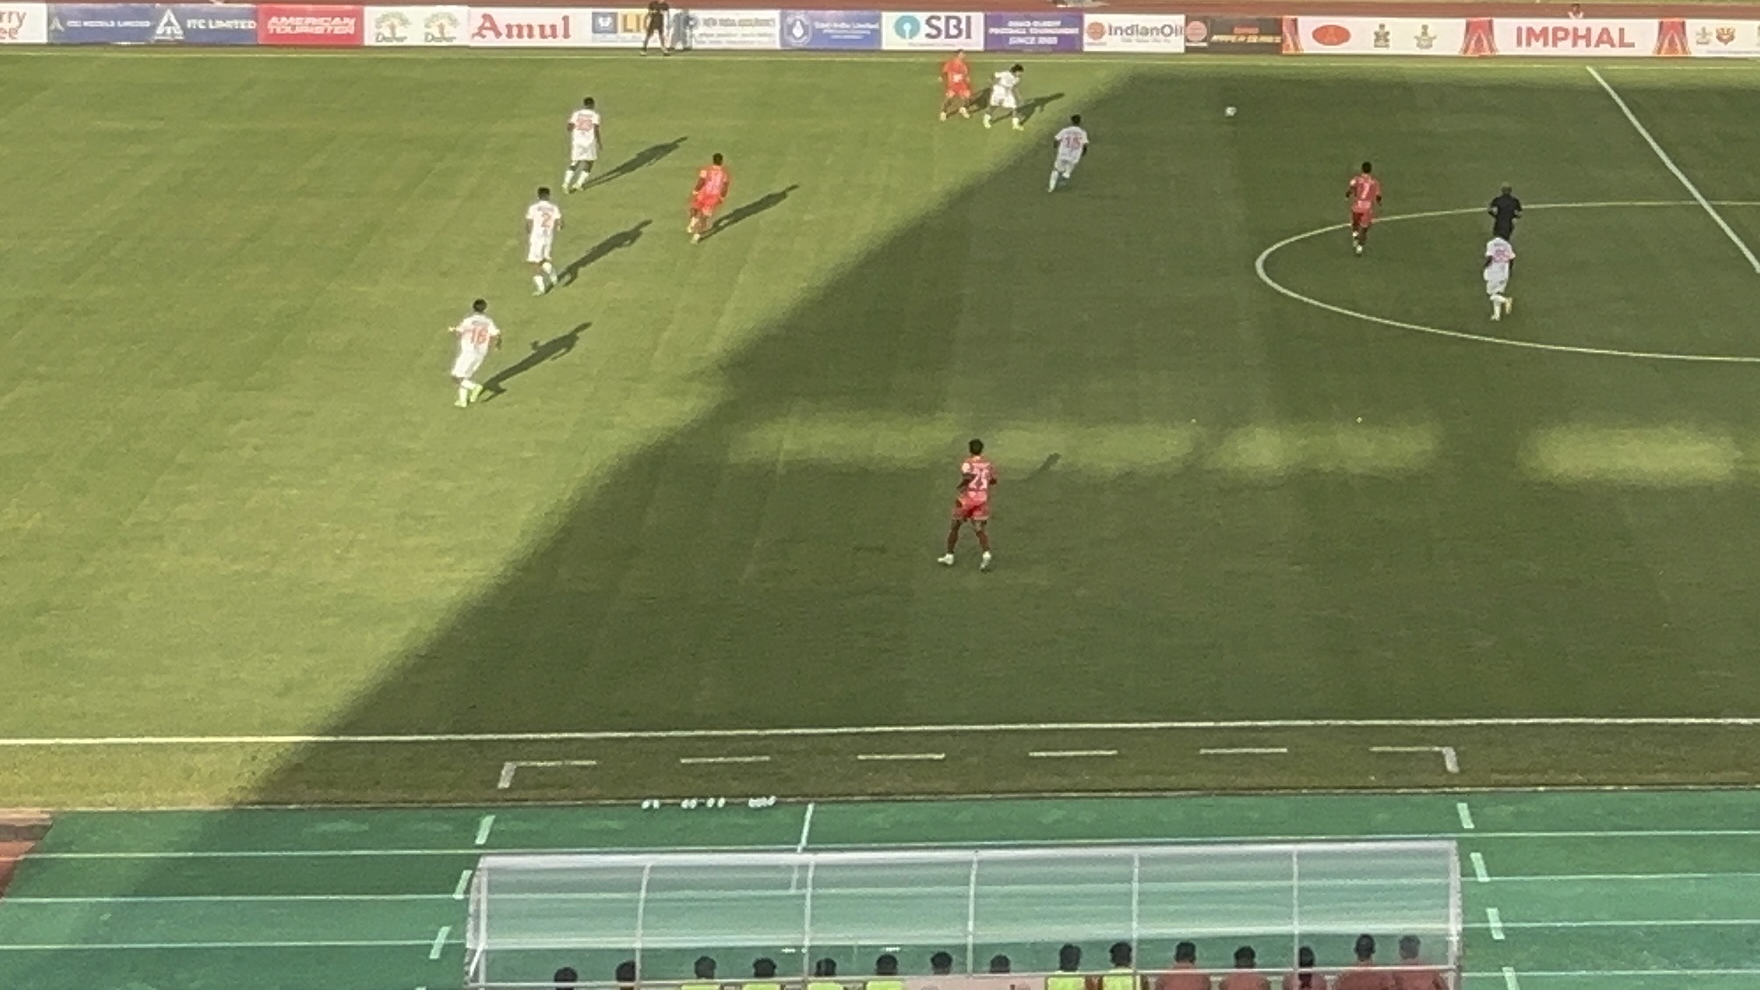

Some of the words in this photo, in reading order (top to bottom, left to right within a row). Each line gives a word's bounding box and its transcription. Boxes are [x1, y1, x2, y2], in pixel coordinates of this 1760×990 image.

[208, 19, 257, 30] LIMITED
[267, 17, 357, 26] AMERICAN
[472, 13, 572, 40] Amul
[924, 16, 972, 40] SBI
[1108, 24, 1184, 38] IndianOil
[1516, 26, 1635, 48] IMPHAL
